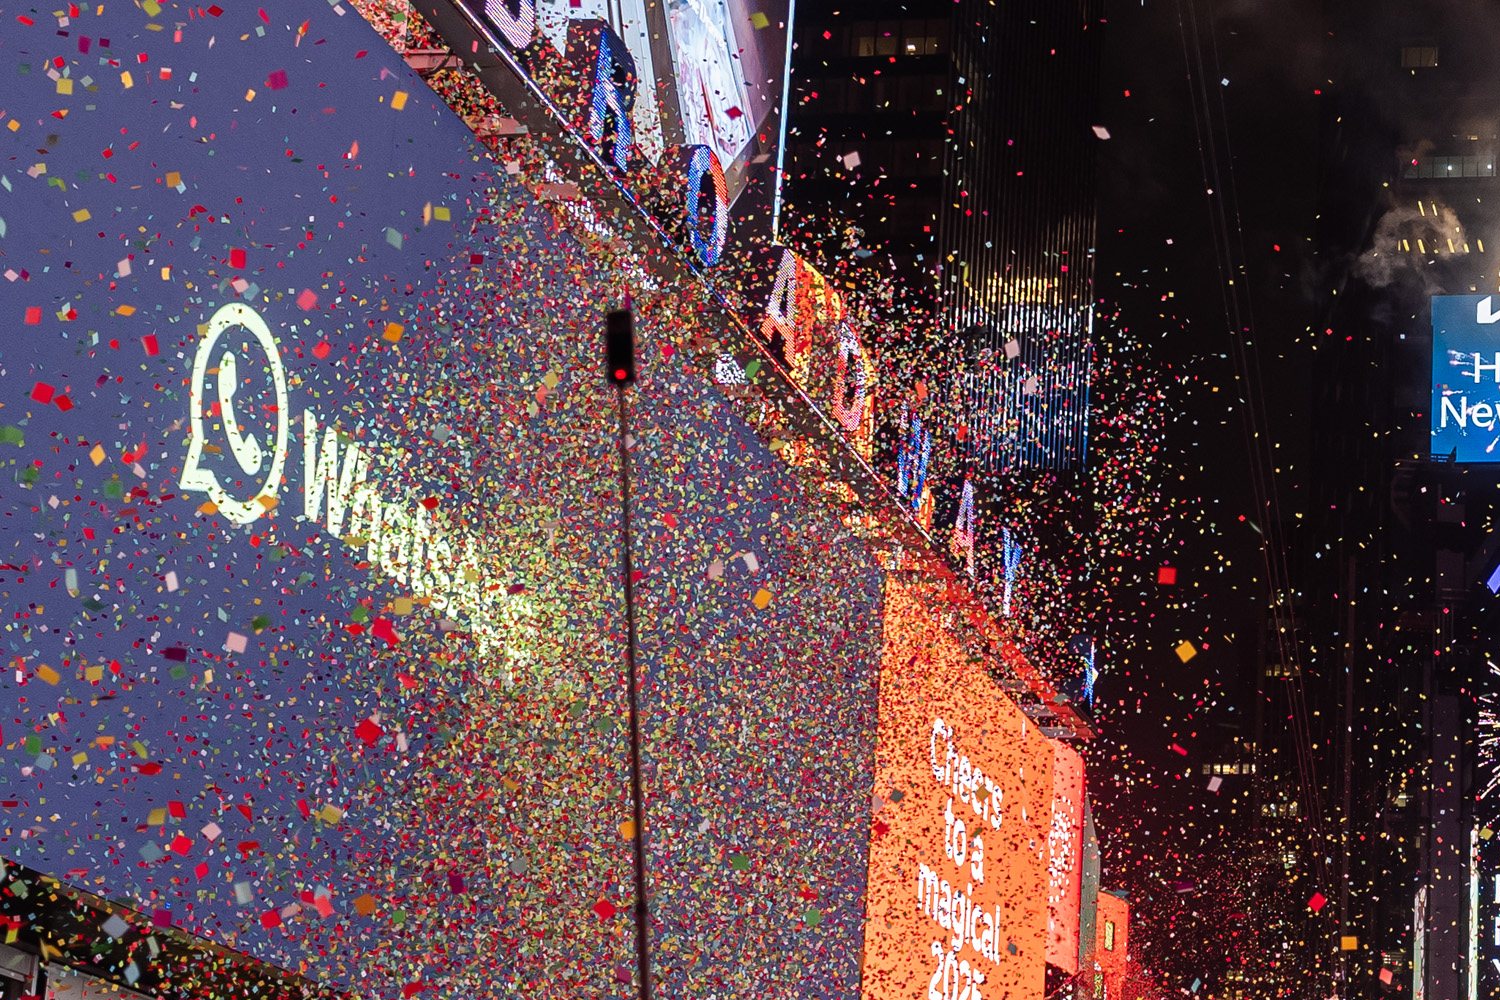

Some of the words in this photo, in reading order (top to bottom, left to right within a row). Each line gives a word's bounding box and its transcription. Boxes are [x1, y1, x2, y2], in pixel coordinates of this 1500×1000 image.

[930, 718, 1003, 831] Cheers
[944, 798, 966, 866] to
[970, 835, 984, 884] a
[918, 862, 1000, 966] magical
